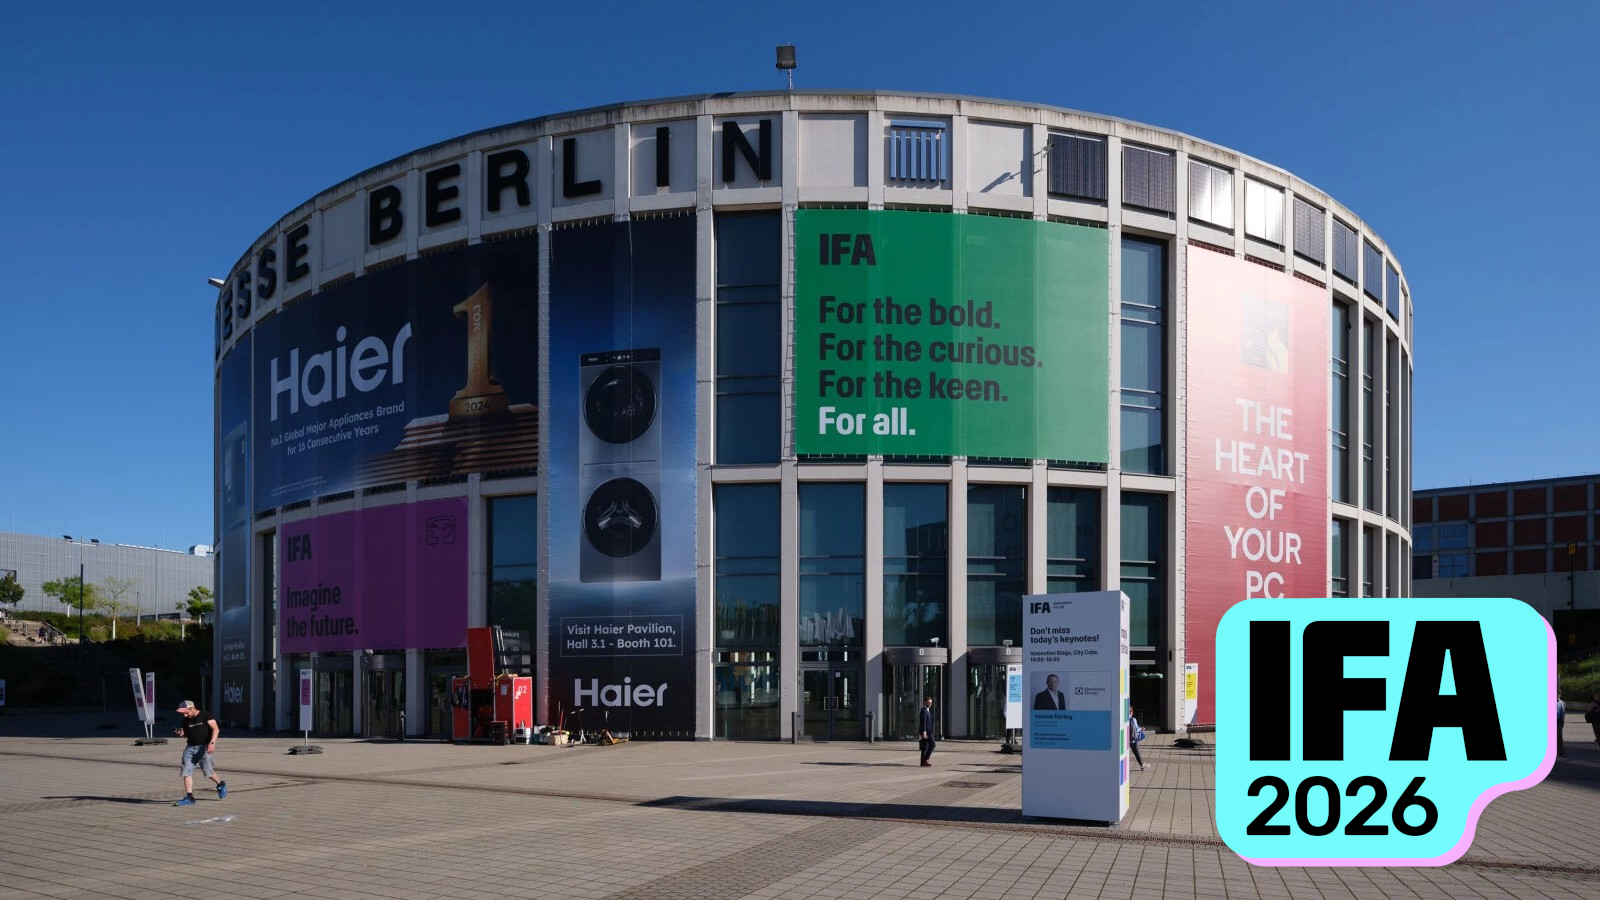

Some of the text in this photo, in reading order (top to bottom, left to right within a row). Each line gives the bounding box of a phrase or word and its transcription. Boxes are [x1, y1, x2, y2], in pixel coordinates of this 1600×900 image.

[370, 119, 772, 245] BERLIN
[819, 233, 877, 266] IFA
[818, 295, 1001, 329] For the bold.
[818, 332, 1044, 368] For the curious.
[270, 321, 413, 422] Haier
[818, 369, 1009, 402] For the keen.
[464, 400, 490, 412] 2024
[818, 406, 917, 436] For all.
[1236, 398, 1293, 441] THE
[270, 401, 405, 447] No.1 Global Major Appliances Brand
[287, 424, 380, 456] for 16 Consecutive Years
[1215, 438, 1310, 484] HEART
[1246, 486, 1286, 520] OF
[287, 534, 312, 563] IFA
[1223, 525, 1302, 564] YOUR
[286, 583, 342, 612] Imagine
[1246, 570, 1285, 598] PC
[1030, 602, 1051, 615] IFA
[286, 614, 359, 639] the future.
[567, 622, 676, 635] Visit Haier Pavilion,
[1030, 626, 1071, 635] Don't miss
[1030, 634, 1100, 645] today's keynotes!
[567, 639, 588, 649] Hall
[591, 639, 606, 649] 3.1
[617, 638, 650, 649] Booth
[654, 637, 677, 648] 101.
[224, 681, 243, 704] Haier
[574, 676, 668, 707] Haier
